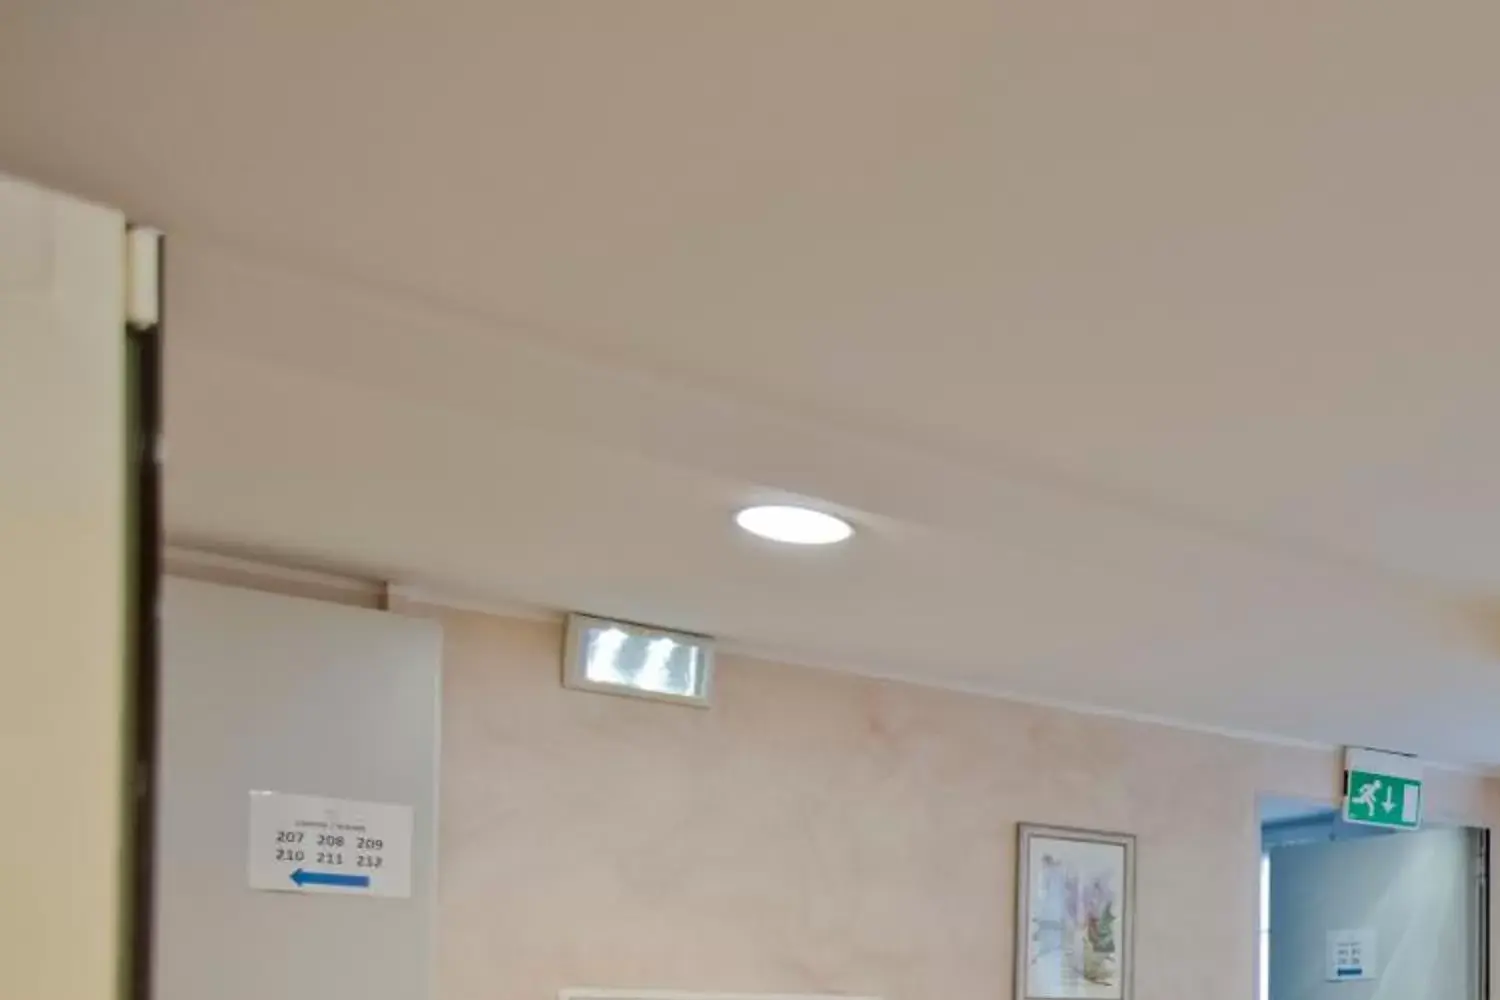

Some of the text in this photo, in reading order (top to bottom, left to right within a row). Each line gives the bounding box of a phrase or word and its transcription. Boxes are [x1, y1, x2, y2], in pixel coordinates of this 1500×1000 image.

[276, 831, 383, 850] 207 208 209
[275, 849, 305, 861] 210
[316, 852, 344, 865] 211
